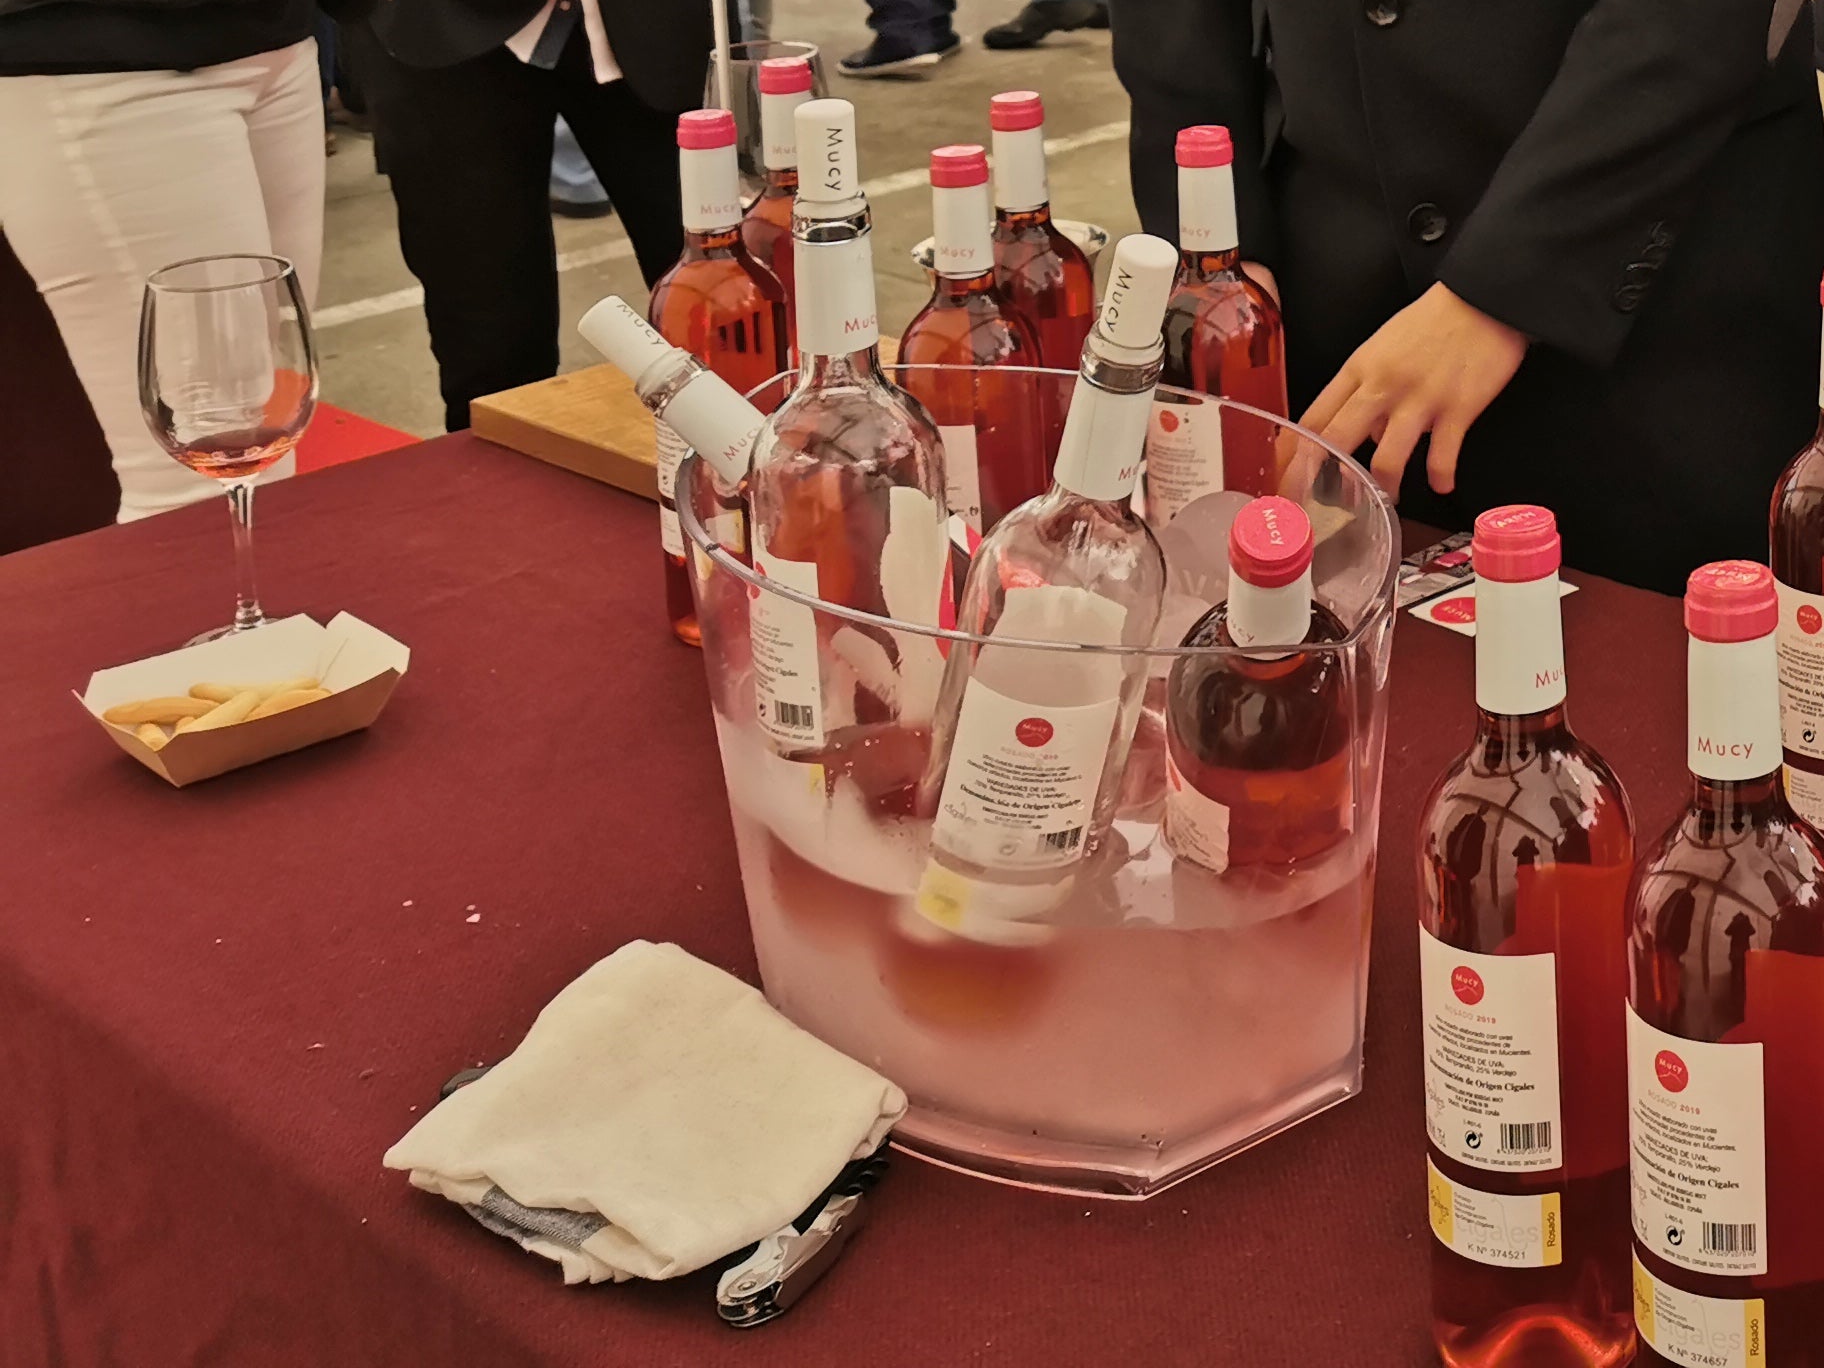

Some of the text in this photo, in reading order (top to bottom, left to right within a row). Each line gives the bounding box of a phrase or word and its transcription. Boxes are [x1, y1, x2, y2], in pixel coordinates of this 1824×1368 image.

[772, 145, 797, 156] Muc
[825, 128, 844, 192] Mucy
[1105, 266, 1134, 333] Mucy
[617, 304, 665, 346] Mucy
[843, 314, 878, 334] Muc
[723, 429, 759, 461] Muc
[1262, 508, 1284, 546] Mucy
[1535, 668, 1564, 688] Muc
[1698, 736, 1753, 759] Mucy
[1659, 1058, 1682, 1074] Mucy
[1465, 1077, 1535, 1092] de Origen Cigales
[1668, 1170, 1740, 1189] de Origen Cigales
[1547, 1212, 1555, 1247] Rosado
[1490, 1249, 1526, 1260] 374521
[1750, 1318, 1759, 1357] Rosado
[1668, 1344, 1674, 1352] K
[1691, 1353, 1728, 1367] 374657
